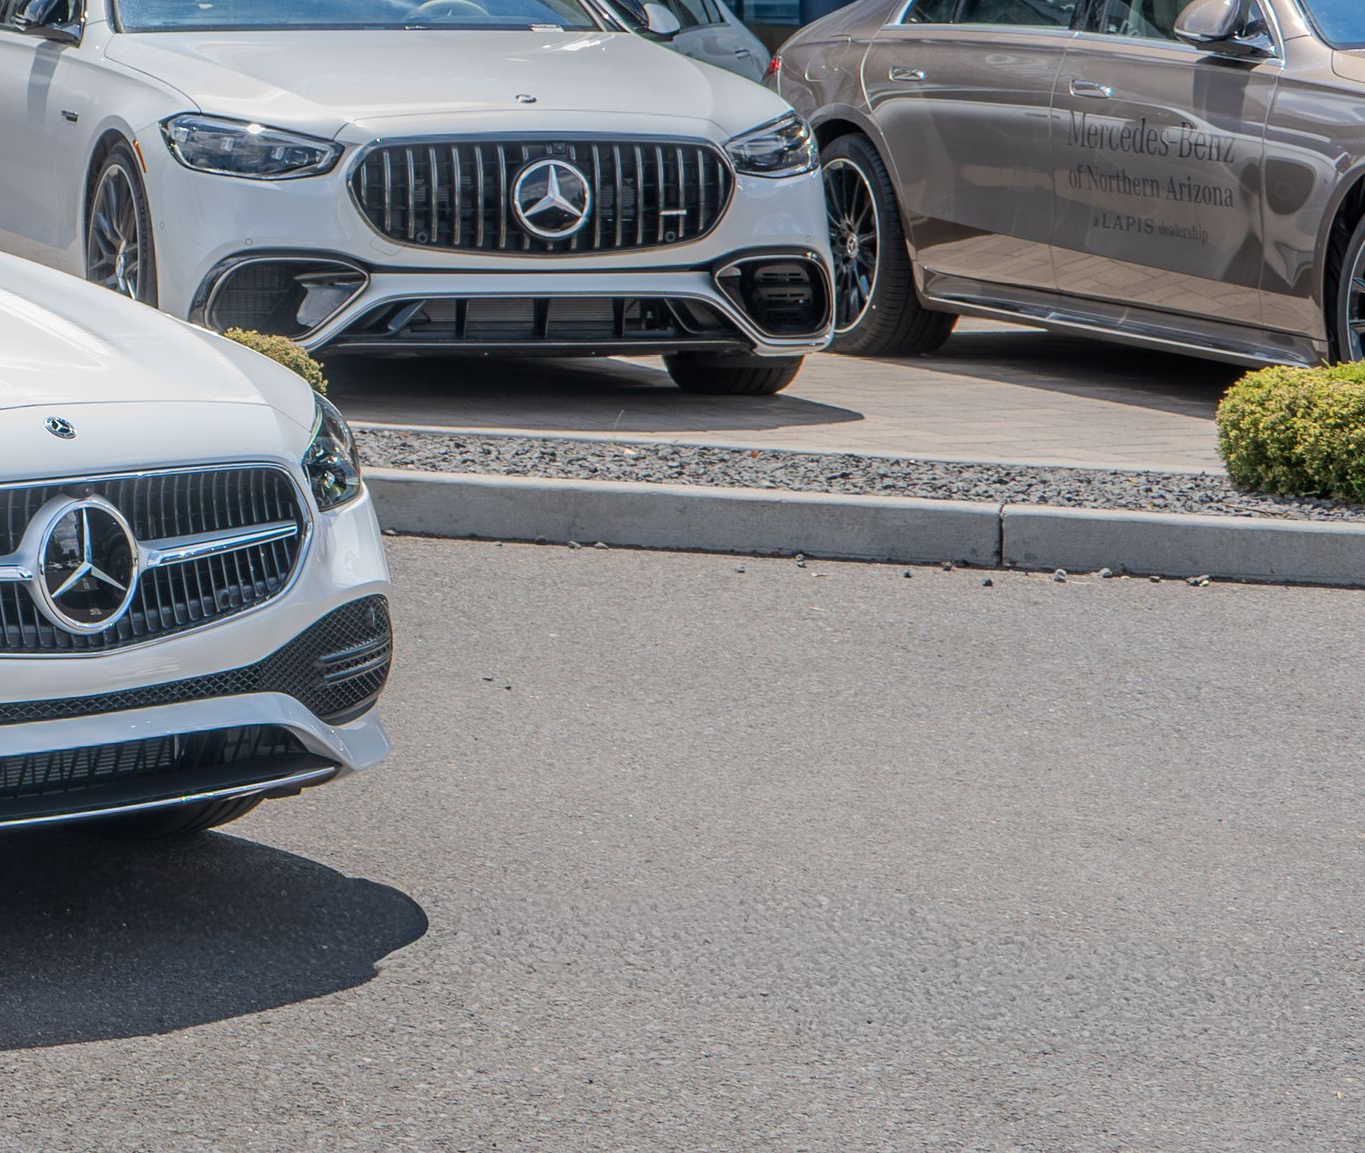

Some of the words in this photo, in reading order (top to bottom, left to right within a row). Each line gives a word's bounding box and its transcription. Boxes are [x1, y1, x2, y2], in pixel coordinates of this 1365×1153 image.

[1066, 110, 1235, 163] Mercedes-Benz
[1068, 162, 1085, 191] of
[1087, 164, 1160, 198] Northern
[1166, 175, 1234, 208] Arizona
[1102, 214, 1154, 235] LAPIS
[1158, 222, 1209, 245] dealership
